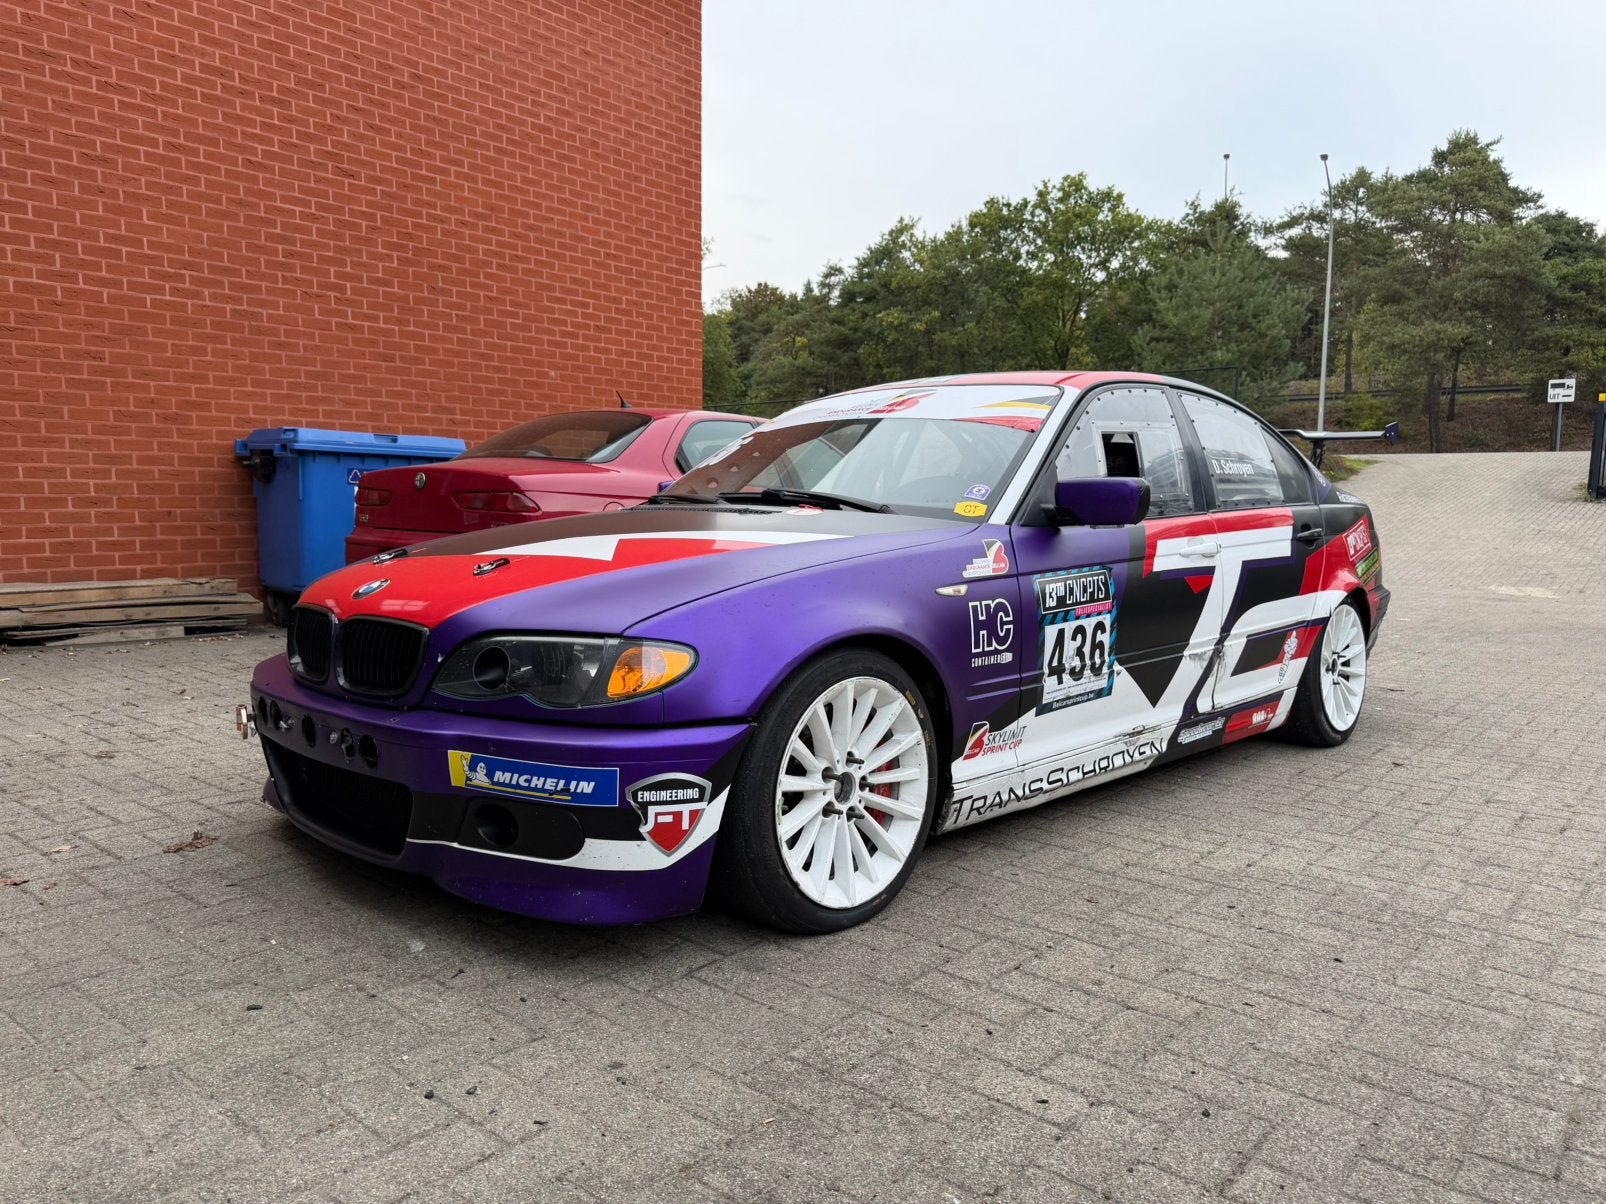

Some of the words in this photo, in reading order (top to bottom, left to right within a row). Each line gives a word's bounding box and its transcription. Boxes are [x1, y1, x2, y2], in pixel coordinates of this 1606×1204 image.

[1220, 459, 1255, 478] Schroyen
[963, 504, 980, 514] GT
[1066, 575, 1105, 604] CNCPTS
[969, 598, 1013, 653] HC
[1047, 621, 1106, 685] 436
[985, 725, 1027, 746] SKYLIMIT
[981, 743, 1008, 757] SPRINT
[1009, 739, 1023, 750] CUP
[493, 770, 596, 794] MICHELIN
[637, 787, 700, 803] ENGINEERING
